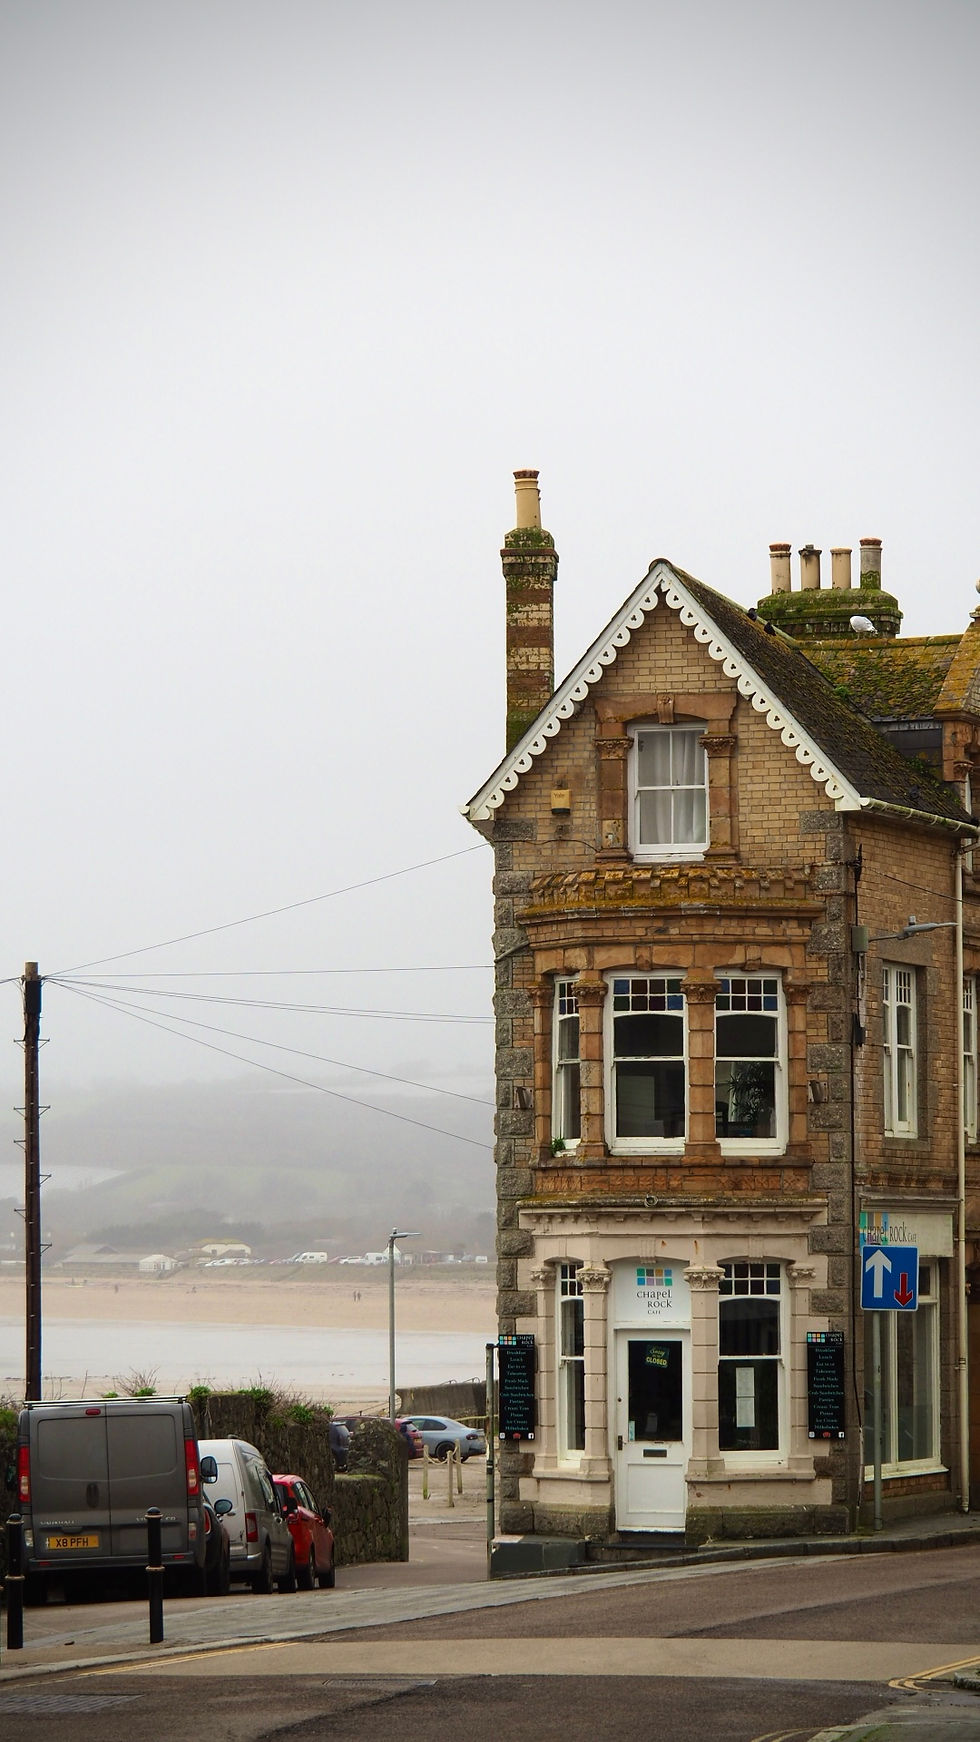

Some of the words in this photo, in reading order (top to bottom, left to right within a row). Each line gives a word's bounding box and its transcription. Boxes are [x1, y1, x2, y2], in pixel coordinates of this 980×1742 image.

[645, 1356, 668, 1366] CLOSED
[56, 1538, 68, 1548] X8
[70, 1537, 89, 1547] PFH
